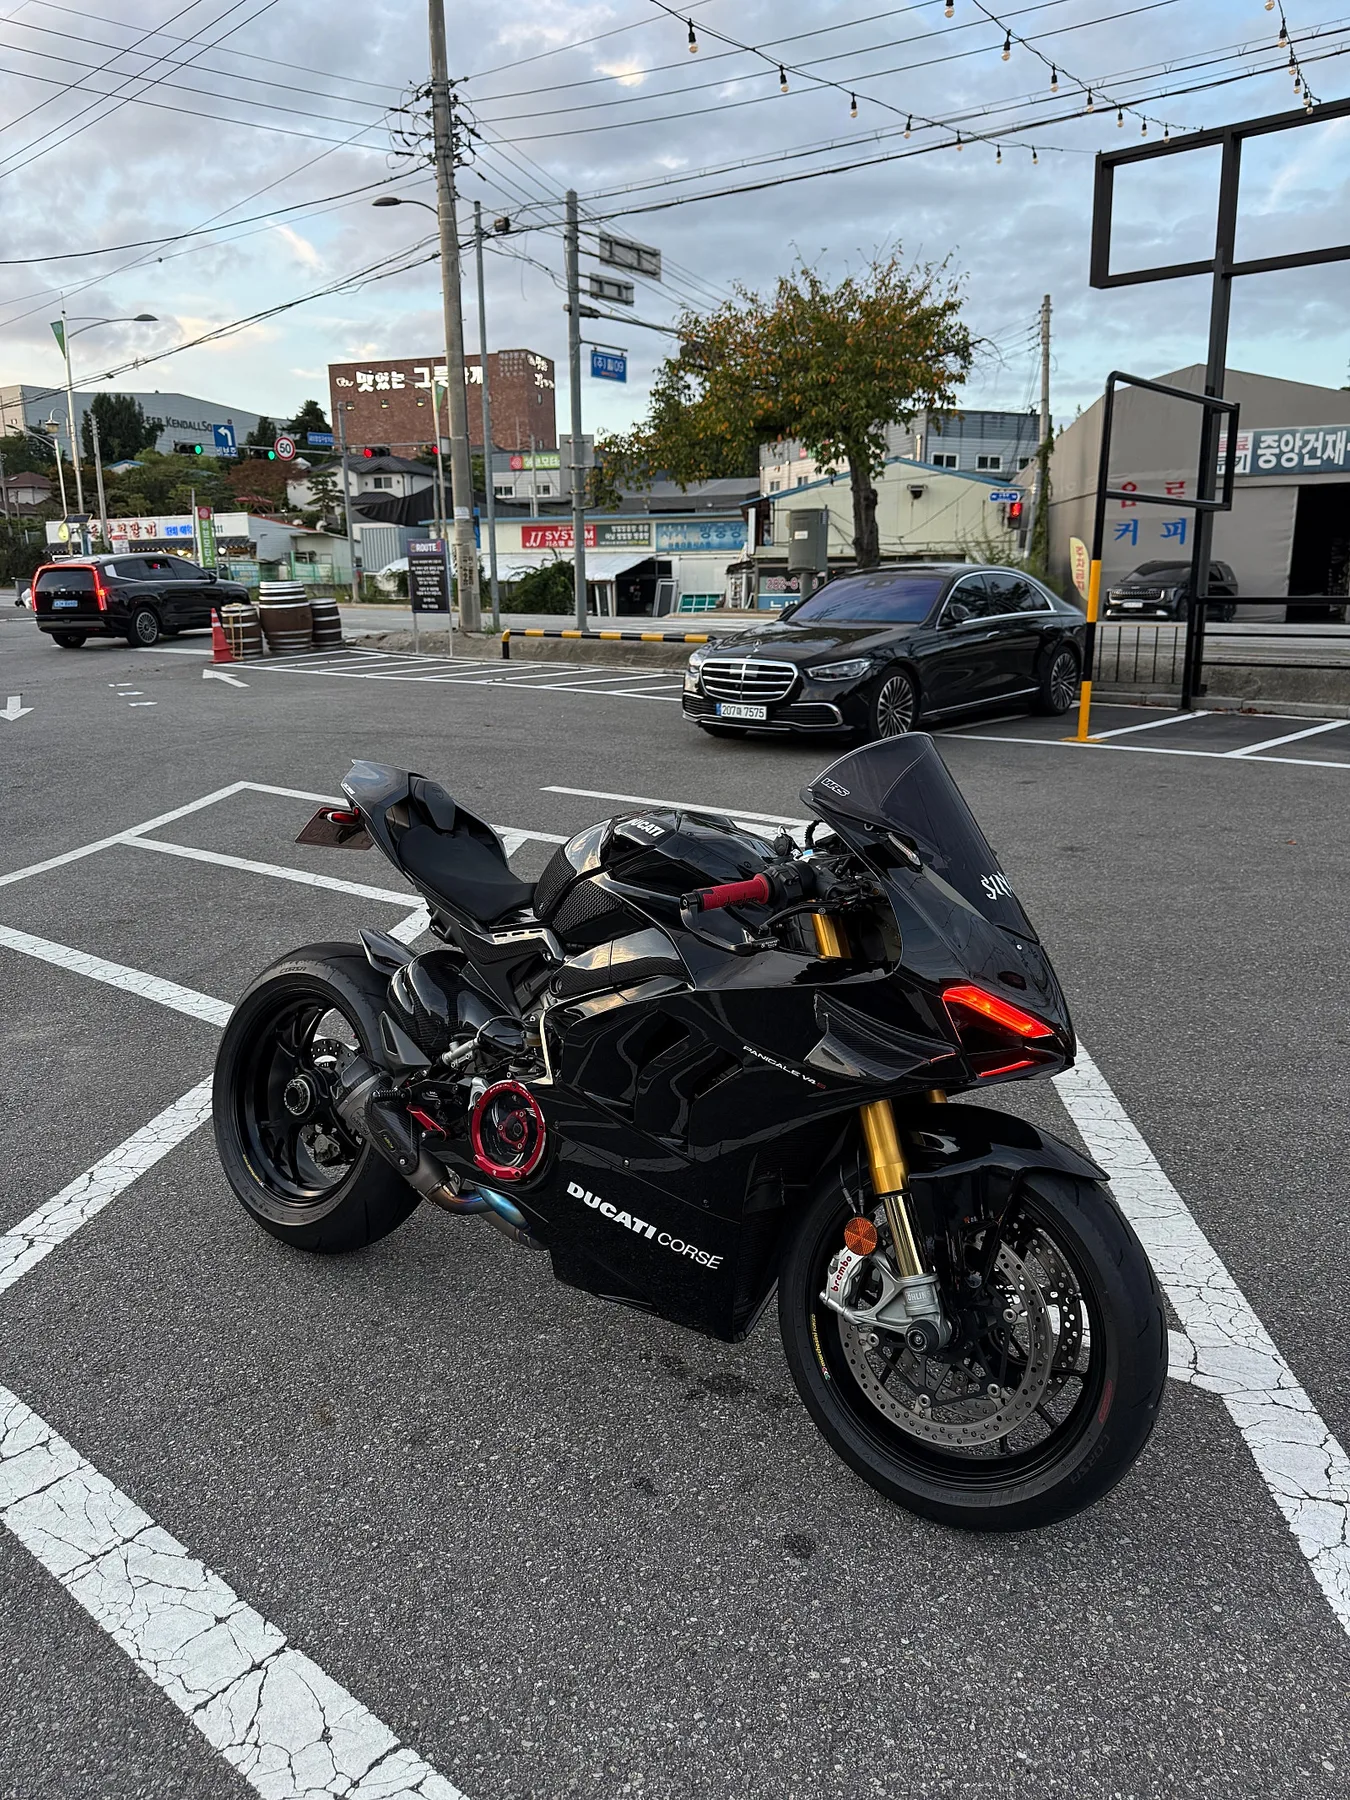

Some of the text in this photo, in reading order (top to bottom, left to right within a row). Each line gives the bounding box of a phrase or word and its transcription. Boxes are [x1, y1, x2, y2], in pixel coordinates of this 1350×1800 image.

[356, 371, 405, 392] 맛있는
[279, 443, 291, 454] 50
[1256, 429, 1350, 469] 중앙건재
[525, 531, 543, 547] JJ
[545, 530, 594, 541] SYSTM
[1114, 518, 1187, 545] 커피
[744, 706, 765, 718] 7575
[566, 1181, 724, 1270] DUCATI CORSE
[830, 1255, 852, 1292] brembo
